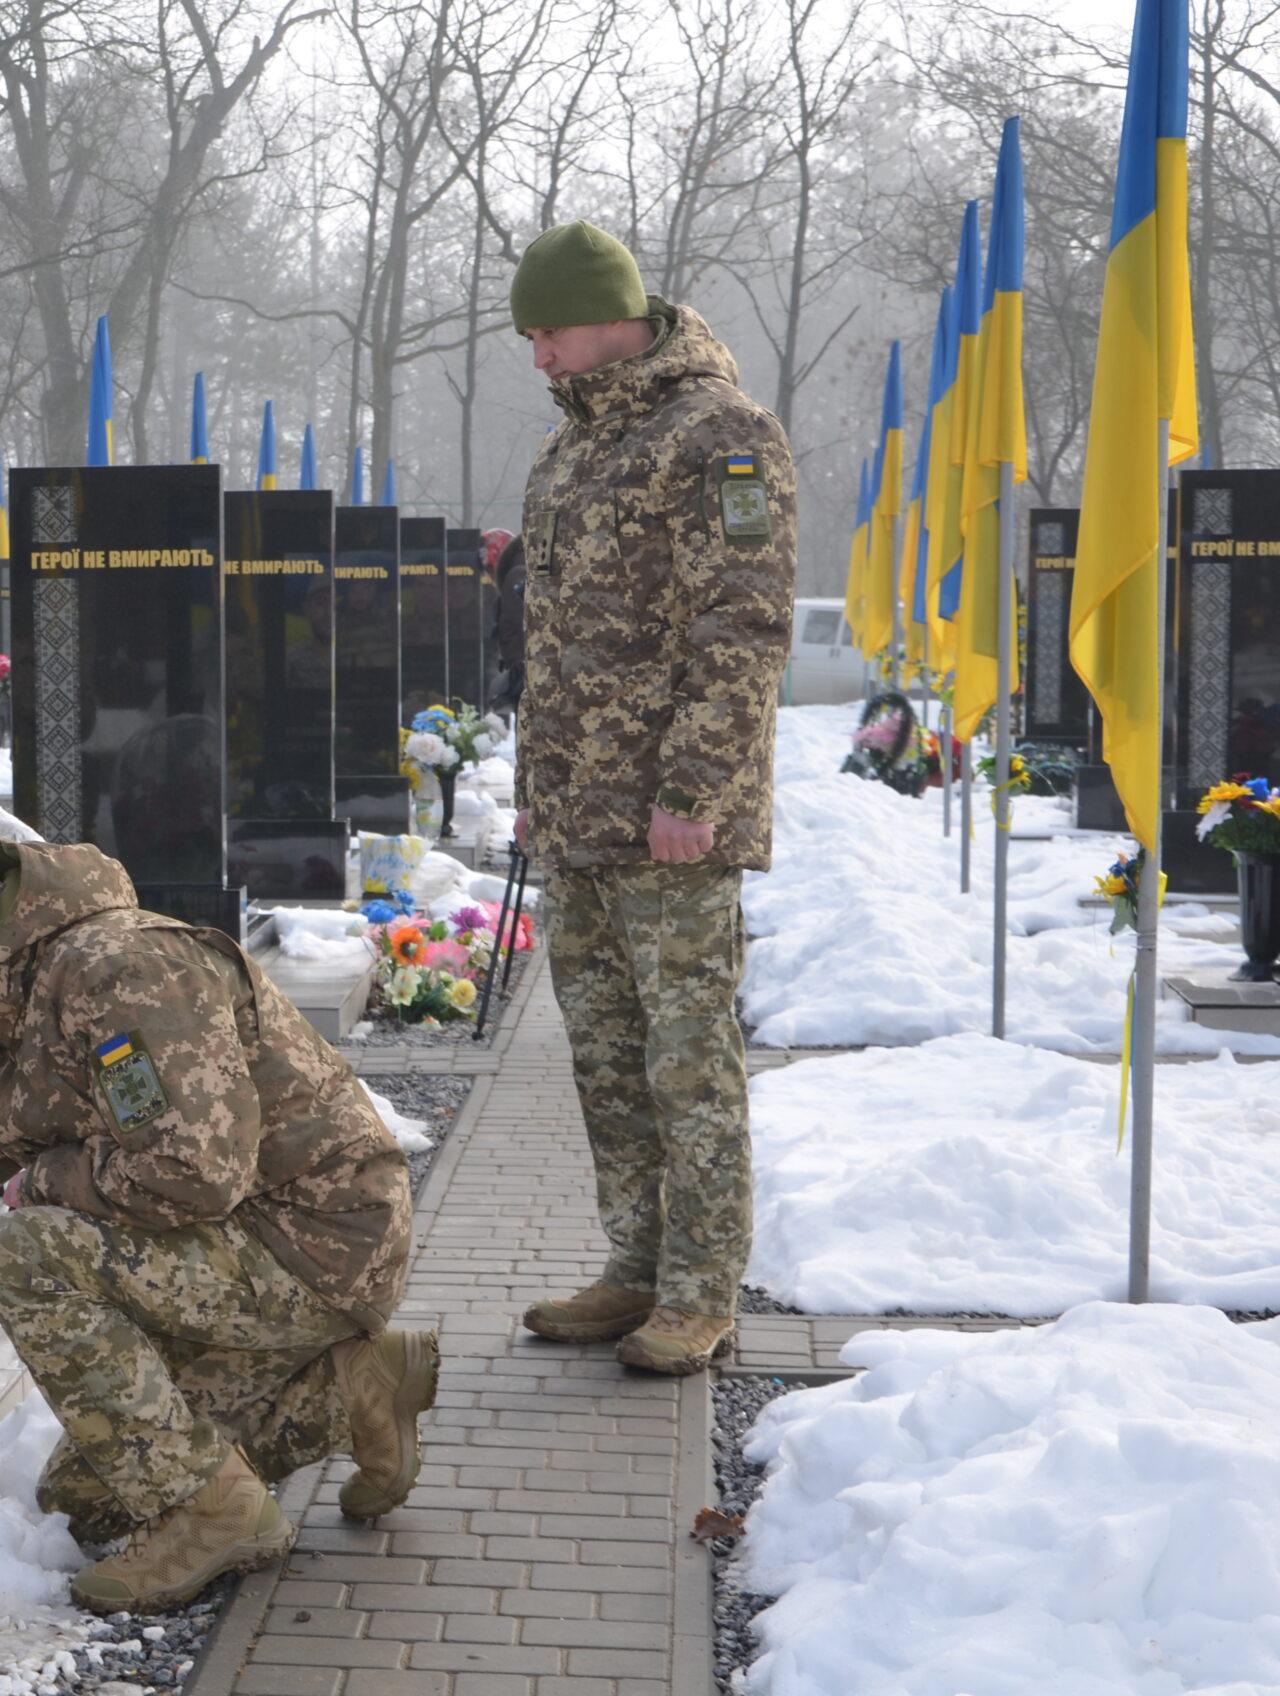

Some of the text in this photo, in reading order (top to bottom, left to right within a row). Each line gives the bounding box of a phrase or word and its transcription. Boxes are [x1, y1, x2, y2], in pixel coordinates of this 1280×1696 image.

[1192, 539, 1233, 556] ГЕРОЇ
[1235, 541, 1255, 556] НЕ
[31, 548, 214, 570] ГЕРОЇ НЕ ВМИРАЮТЬ
[242, 560, 324, 575] ВМИРАЮТЬ
